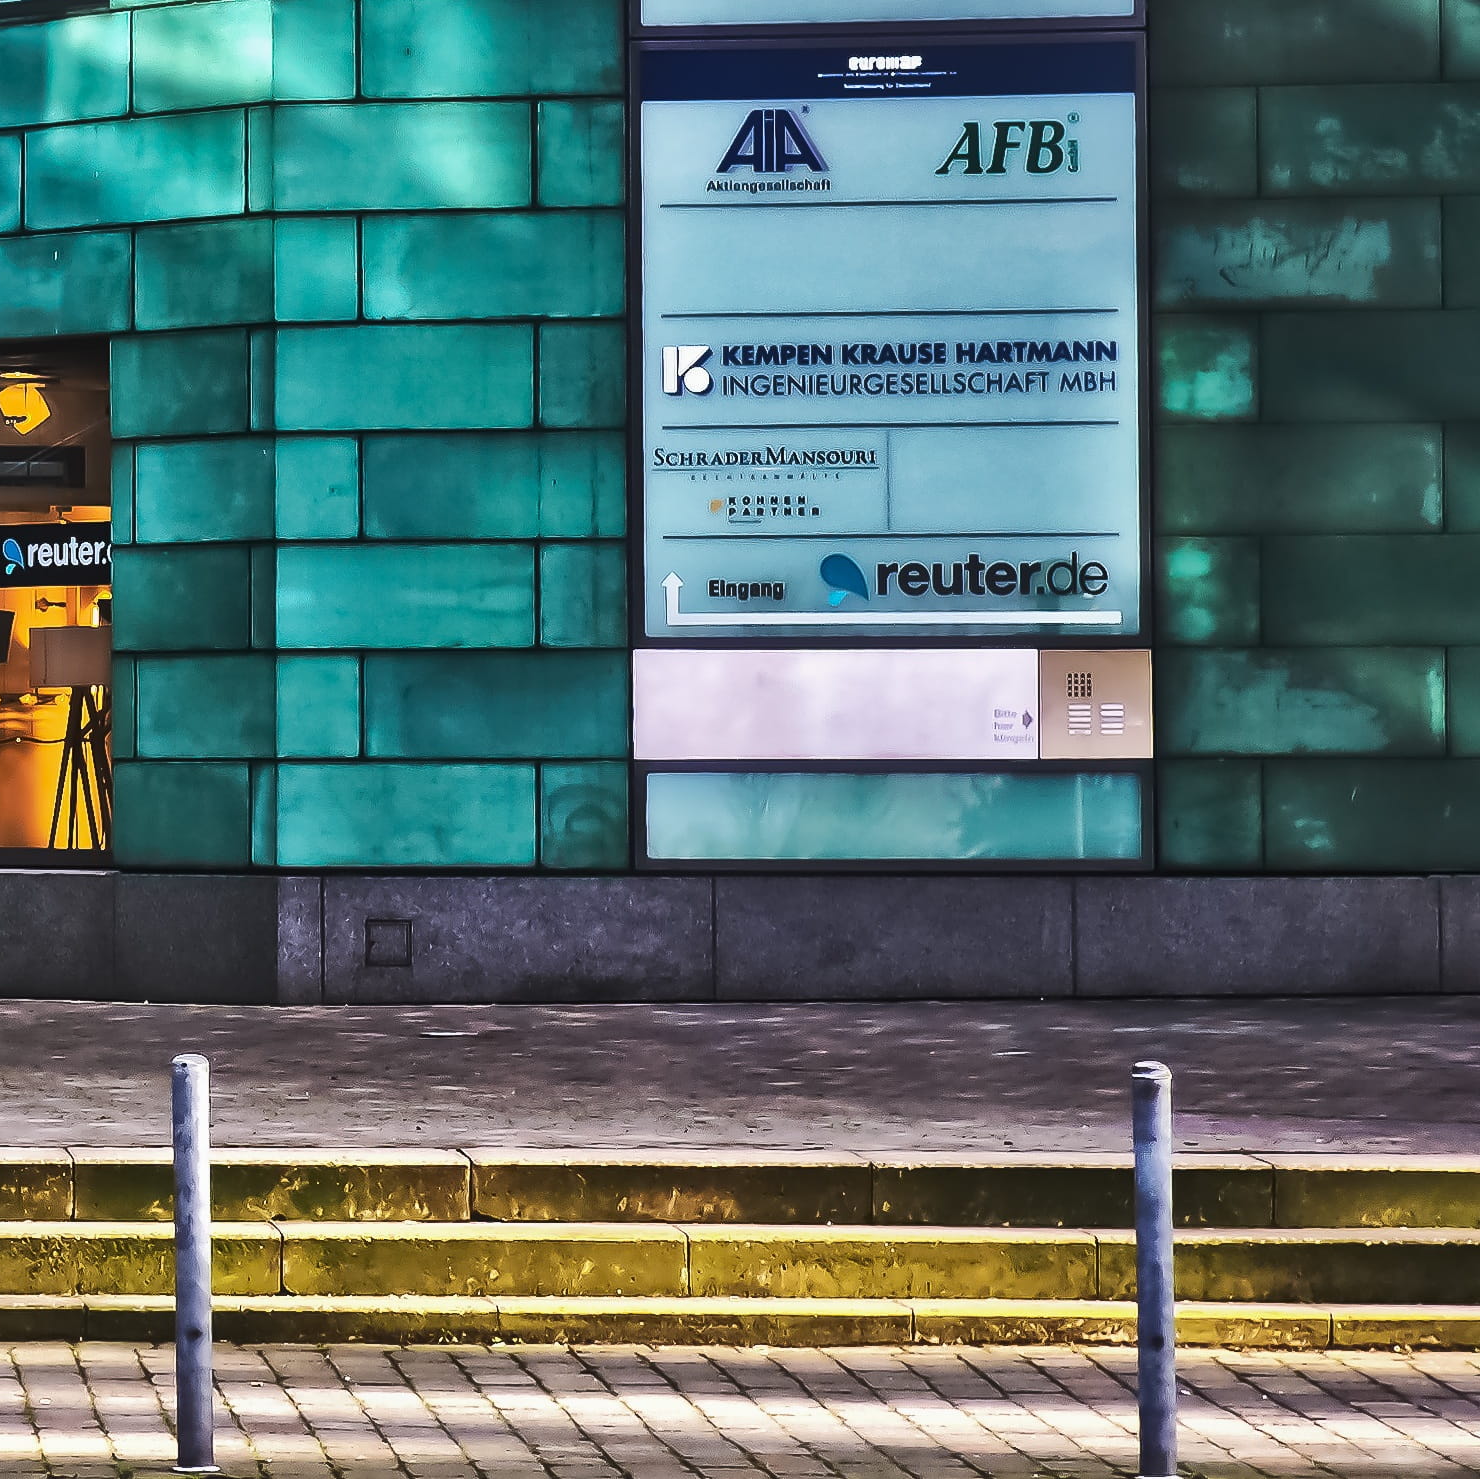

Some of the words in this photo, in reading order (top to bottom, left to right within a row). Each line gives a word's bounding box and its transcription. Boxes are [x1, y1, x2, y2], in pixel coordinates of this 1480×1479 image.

[721, 343, 833, 367] KEMPEN
[841, 341, 946, 365] KRAUSE
[955, 340, 1117, 363] HARTMANN
[722, 372, 1049, 396] INGENIEURGESELLSCHAFT
[1059, 370, 1117, 393] MBH
[653, 446, 877, 467] SCHRADERMANSOURI
[728, 507, 820, 518] PARTNER
[708, 578, 784, 600] Eingang
[876, 551, 1109, 596] reuter.de
